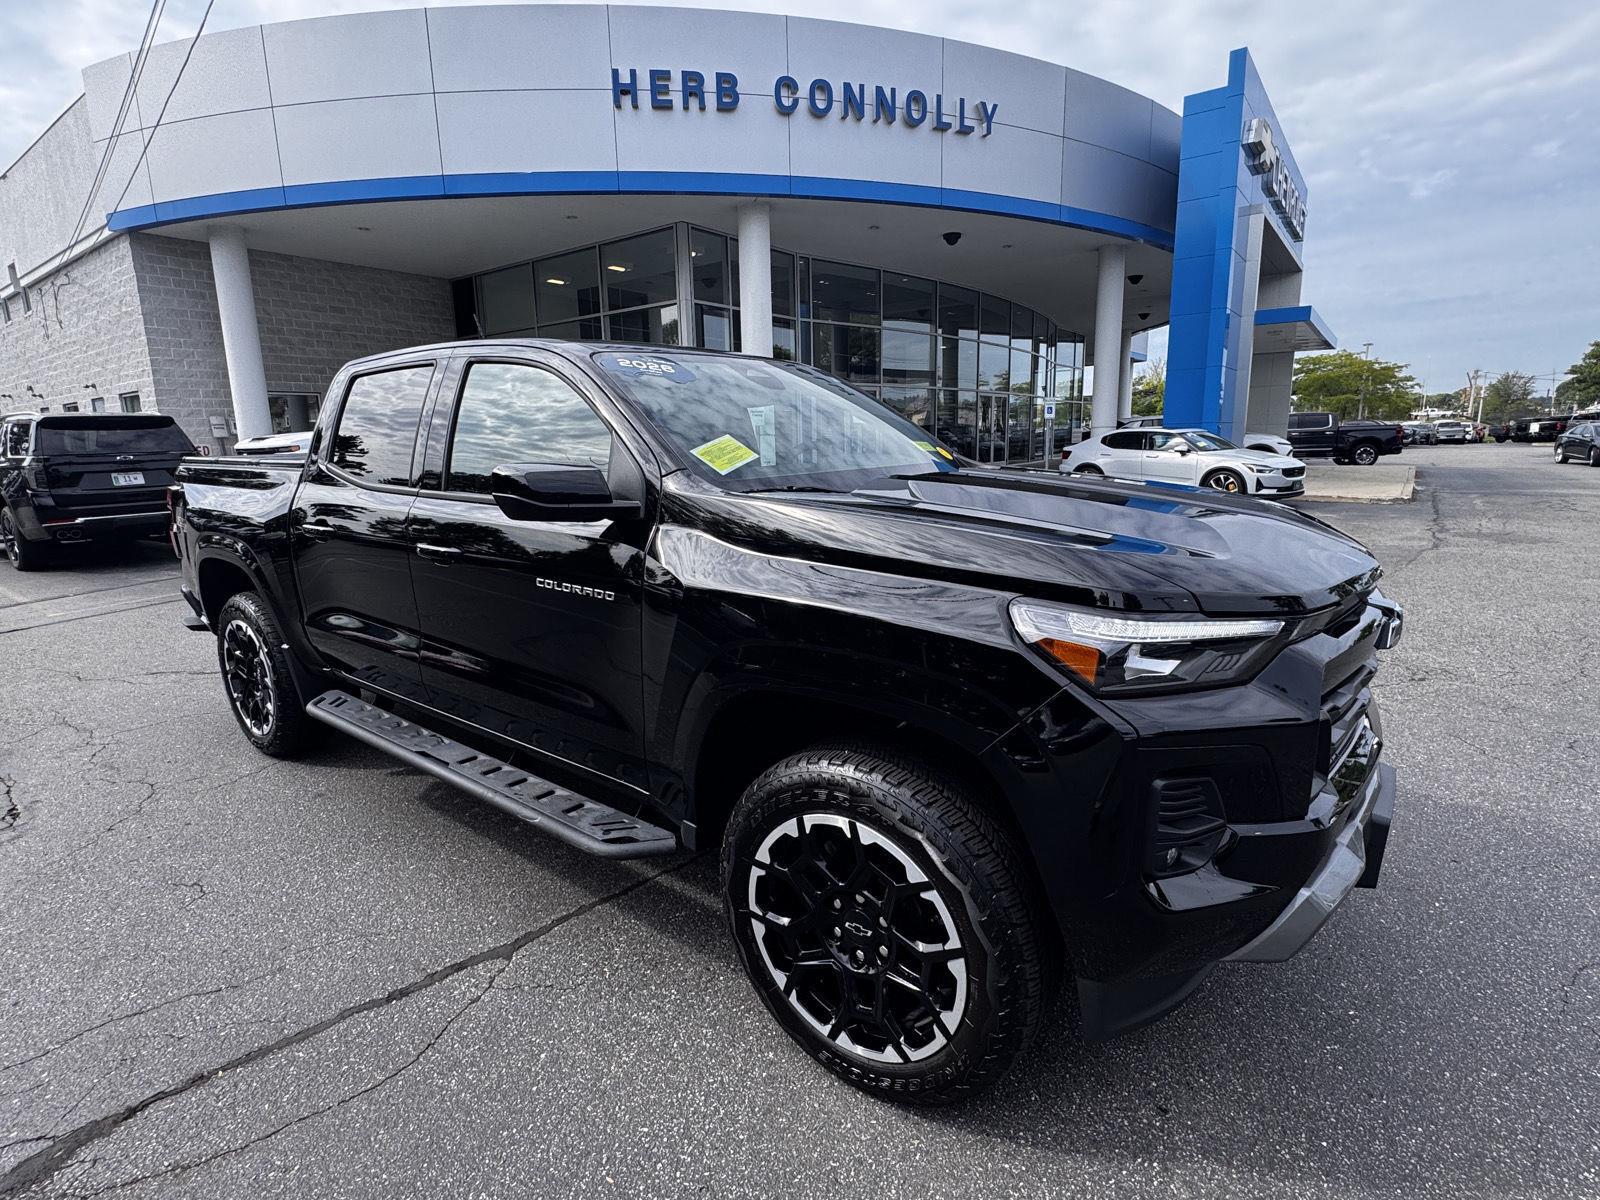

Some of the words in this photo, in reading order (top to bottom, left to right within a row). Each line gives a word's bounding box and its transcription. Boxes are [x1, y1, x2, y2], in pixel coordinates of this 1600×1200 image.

[611, 67, 741, 112] HERB
[774, 75, 999, 138] CONNOLLY
[535, 577, 615, 601] COLORADO
